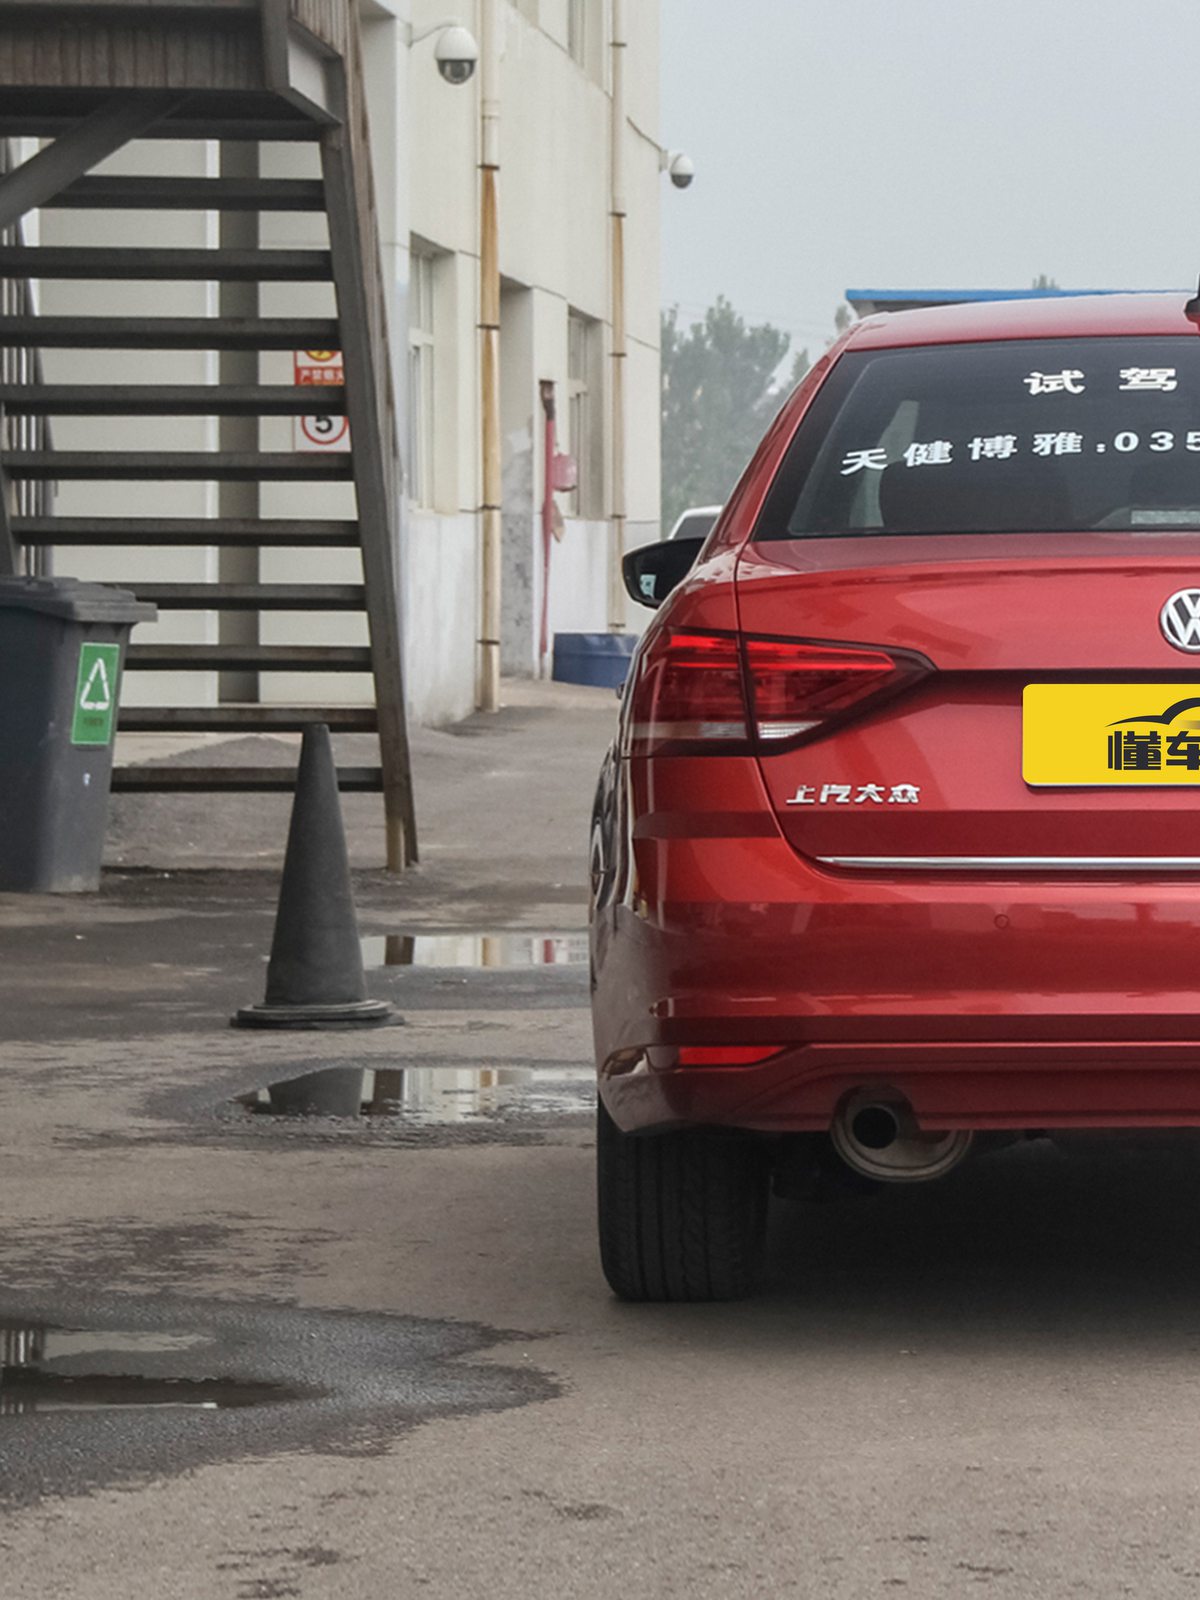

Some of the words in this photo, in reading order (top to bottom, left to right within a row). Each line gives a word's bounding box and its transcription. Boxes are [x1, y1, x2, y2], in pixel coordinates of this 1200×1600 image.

[315, 415, 333, 434] 5
[785, 783, 921, 804] 上汽大众
